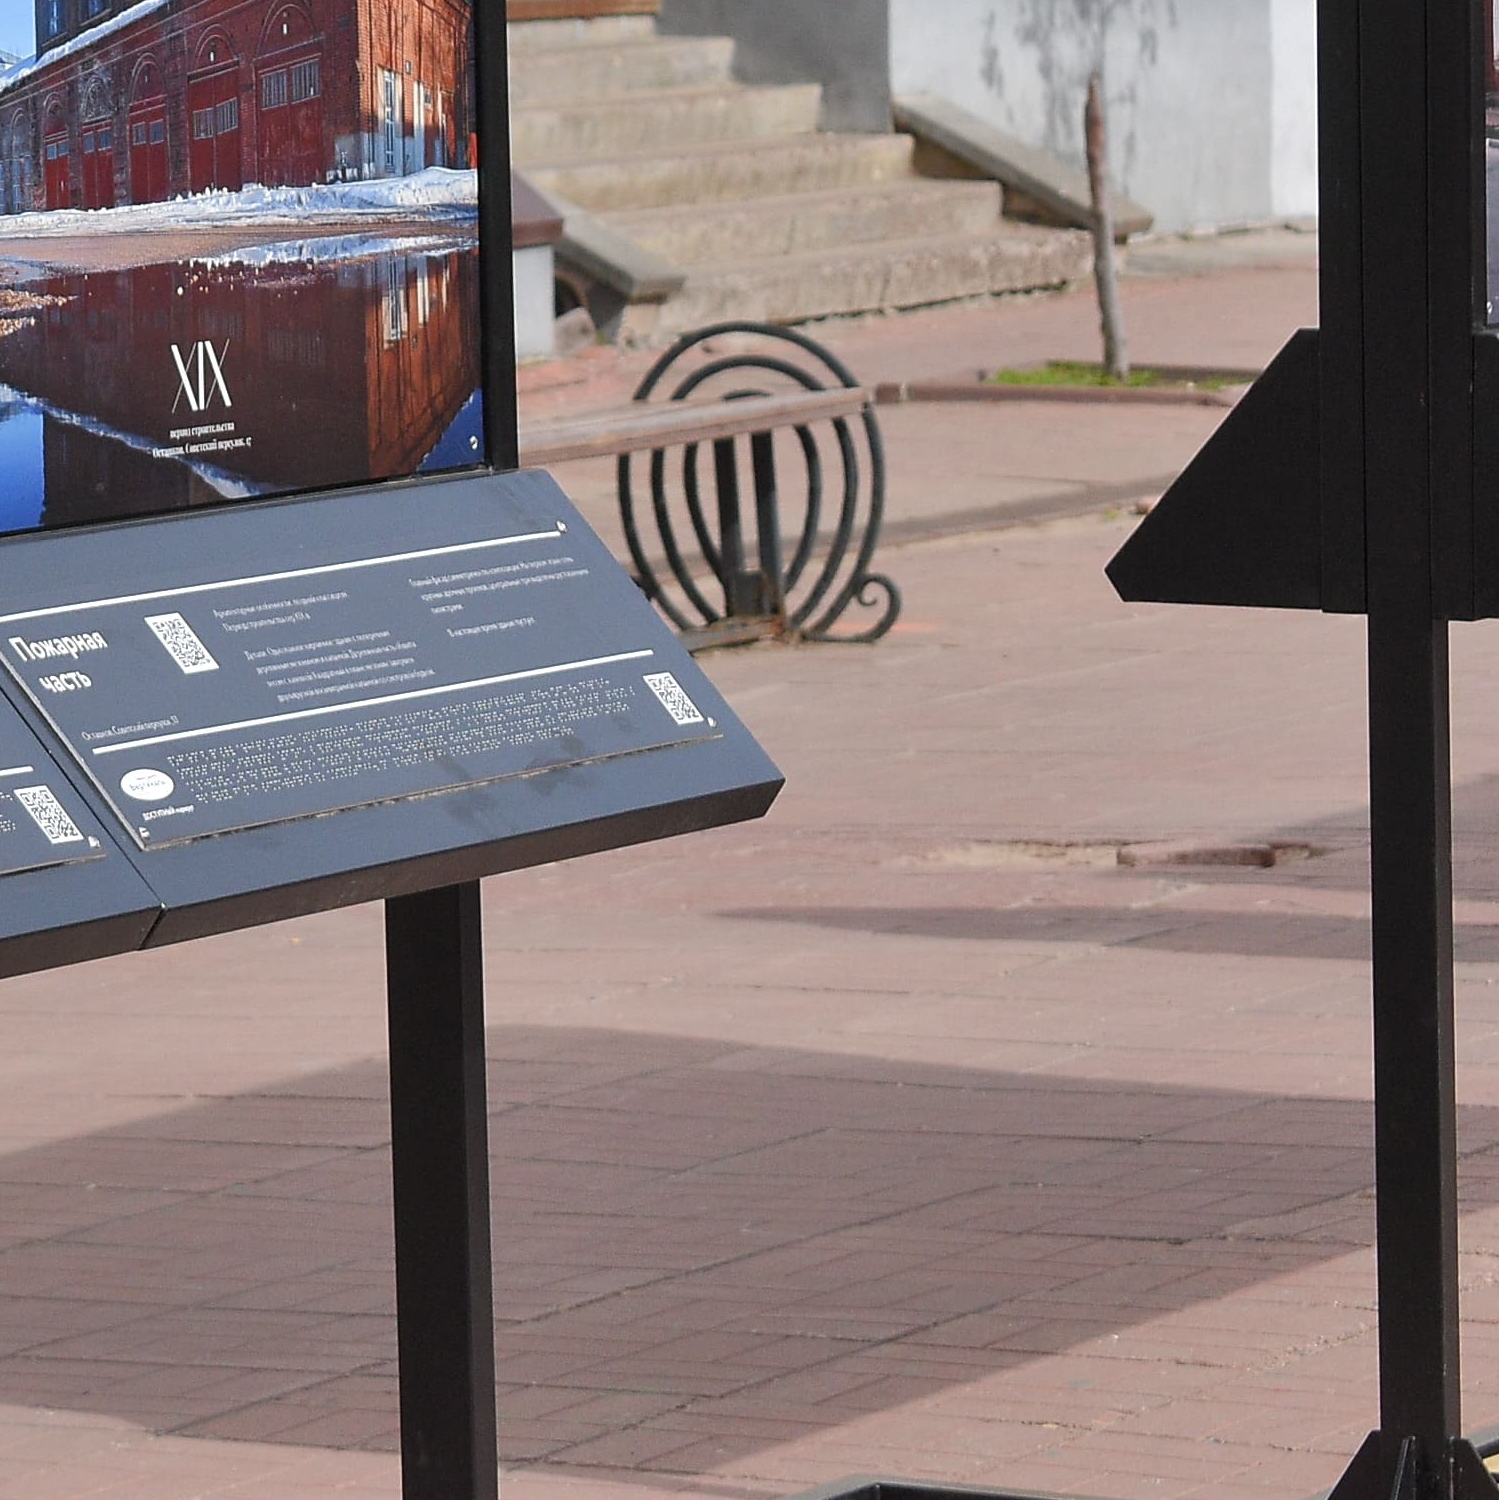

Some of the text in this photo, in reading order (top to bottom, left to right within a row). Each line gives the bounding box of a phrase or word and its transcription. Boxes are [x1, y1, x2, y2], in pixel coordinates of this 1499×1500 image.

[170, 338, 233, 414] XIX
[8, 631, 108, 662] Пожарная
[38, 670, 92, 693] часть
